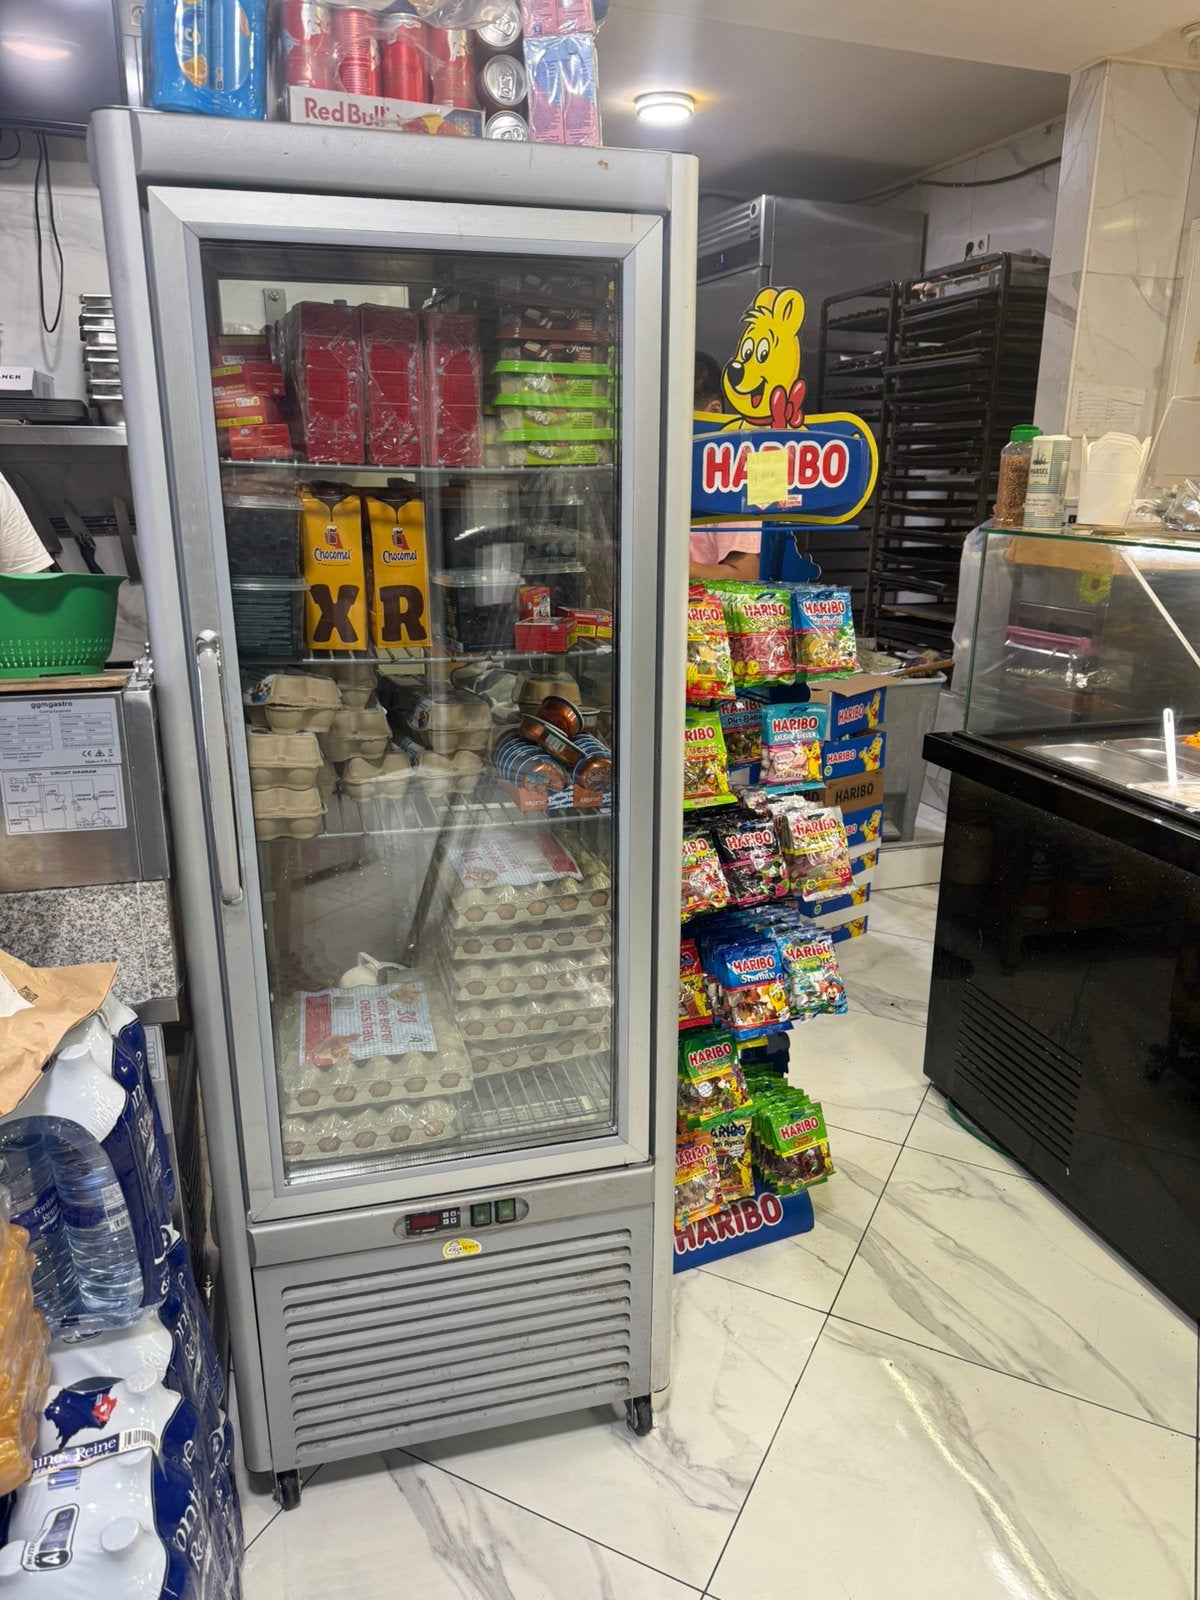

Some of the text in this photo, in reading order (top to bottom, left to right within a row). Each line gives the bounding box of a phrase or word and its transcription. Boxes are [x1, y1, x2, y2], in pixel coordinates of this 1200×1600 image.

[304, 97, 386, 128] Red Bull
[704, 441, 849, 491] HAIBO
[314, 548, 351, 562] Chocomel
[383, 550, 417, 563] Chocomel
[309, 584, 360, 643] X
[379, 585, 428, 642] R
[687, 607, 720, 621] ARIBO
[743, 603, 787, 618] HARIBO
[803, 600, 846, 615] HARIBO
[31, 701, 73, 709] ggmgastro
[837, 703, 865, 725] HARIBO
[684, 726, 716, 742] RIBO
[772, 717, 819, 733] HARIBO
[826, 749, 857, 765] HARIBO
[835, 783, 874, 803] HARIBO
[795, 817, 838, 836] HARIBO
[845, 823, 858, 836] IBO
[726, 831, 772, 849] HARIBO
[785, 942, 831, 960] HARIBO
[733, 956, 775, 974] HARIBO
[741, 972, 775, 984] Starmix
[689, 1042, 732, 1067] HARIBO
[781, 1116, 820, 1141] HARIBO
[673, 1192, 782, 1254] HARIBO
[75, 1438, 117, 1460] Reine
